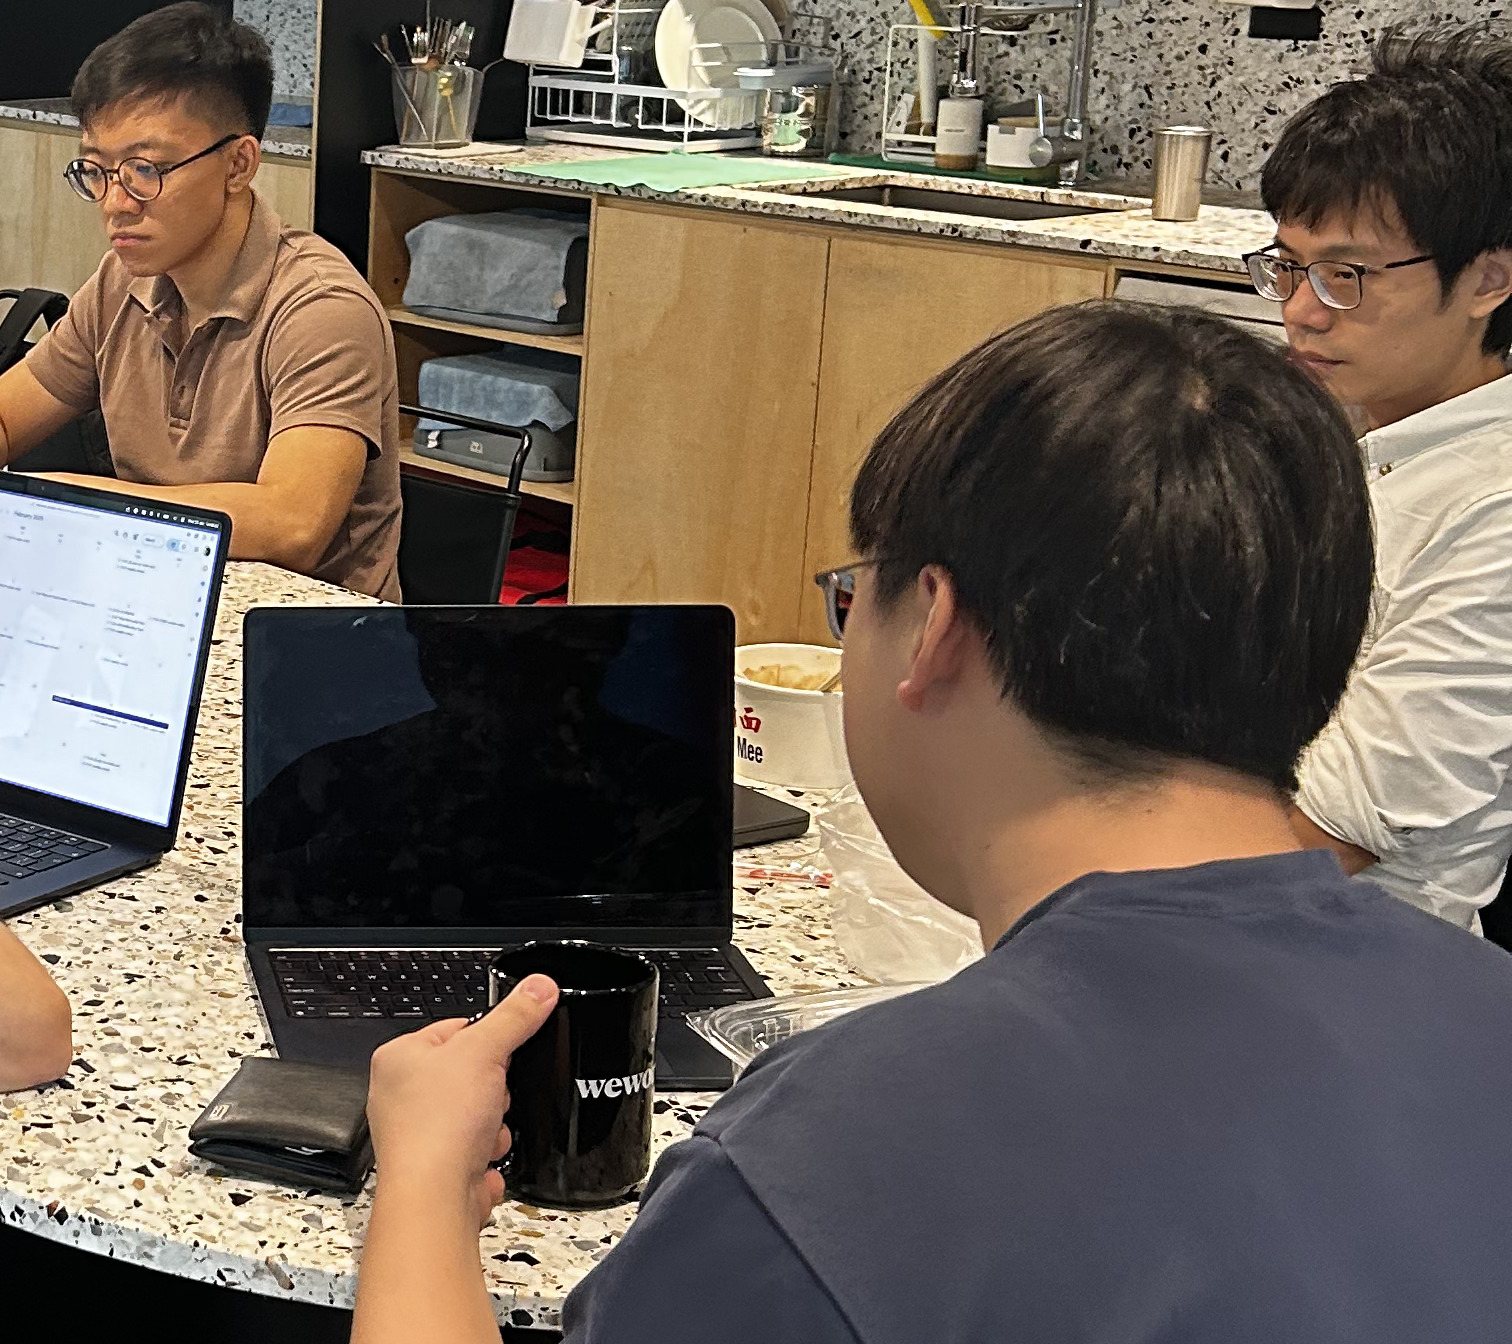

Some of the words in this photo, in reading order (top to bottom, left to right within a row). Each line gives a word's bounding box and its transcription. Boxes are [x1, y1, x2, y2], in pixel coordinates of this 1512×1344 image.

[734, 707, 761, 733] 面
[737, 735, 763, 764] Mee
[574, 1067, 654, 1098] wewo
